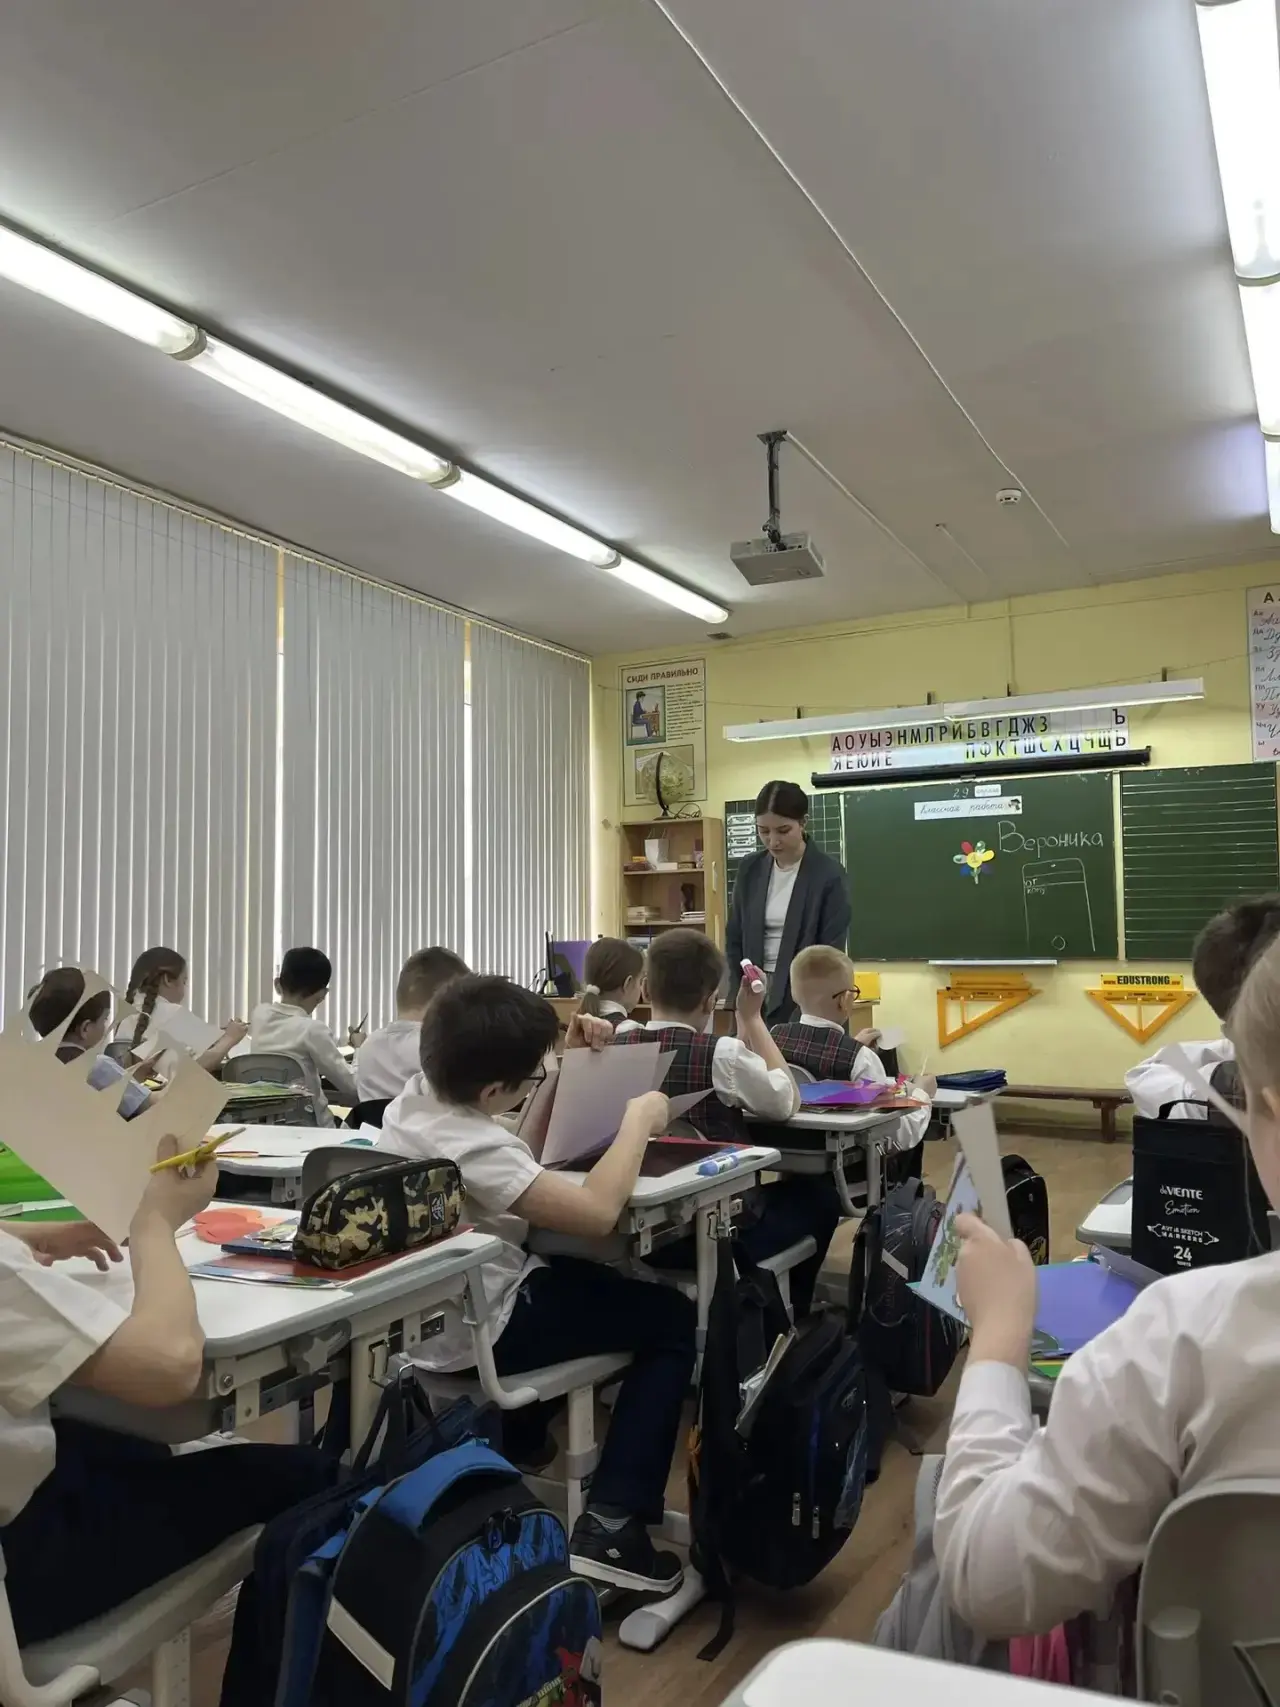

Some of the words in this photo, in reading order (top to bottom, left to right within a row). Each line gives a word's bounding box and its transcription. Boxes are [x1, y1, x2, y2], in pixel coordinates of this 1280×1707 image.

[626, 673, 649, 684] СИДИ
[650, 667, 699, 681] ПРАВИЛЬНО
[920, 803, 962, 815] Классная
[968, 800, 1005, 814] работа
[998, 820, 1104, 858] Вероника
[1117, 975, 1170, 985] EDUSTRONG
[1164, 1200, 1200, 1216] Emotion
[1161, 1231, 1203, 1244] MARKERS
[1174, 1245, 1193, 1262] 24
